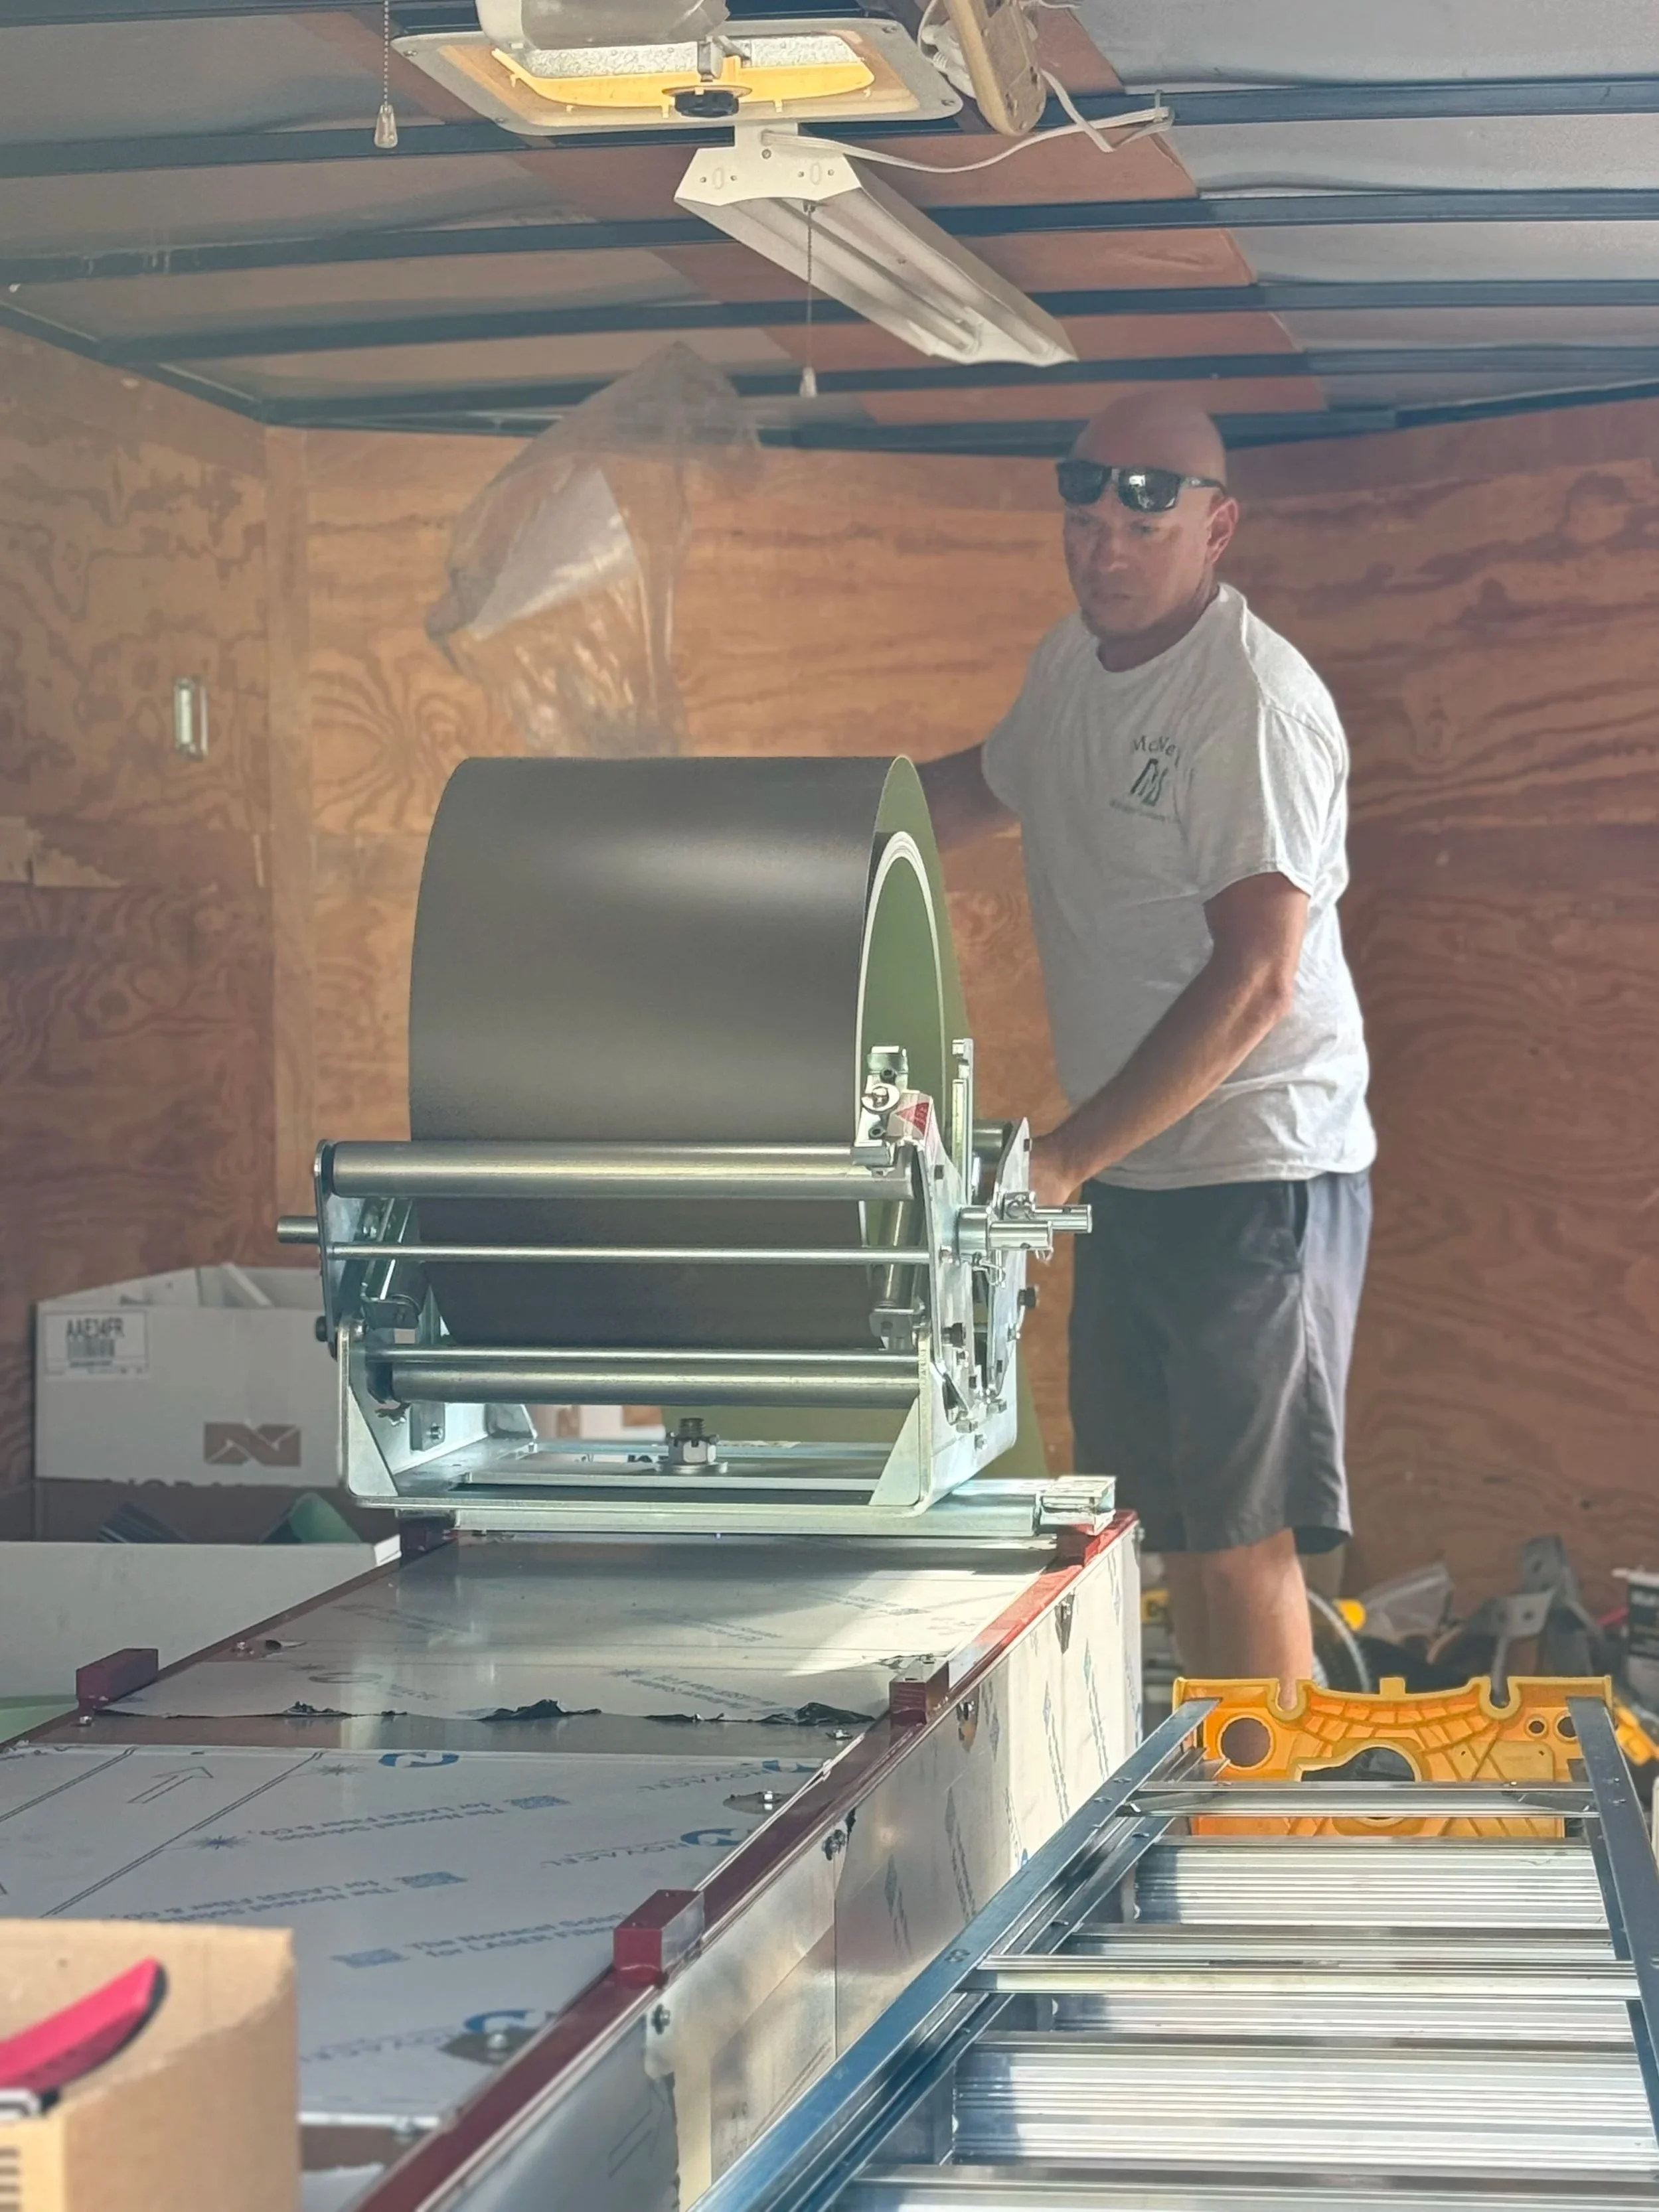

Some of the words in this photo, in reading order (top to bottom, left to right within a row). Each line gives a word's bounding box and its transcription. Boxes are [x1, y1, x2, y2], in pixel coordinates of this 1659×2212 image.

[378, 1807, 455, 1820] LASER
[321, 1817, 378, 1827] Fiber
[374, 1814, 463, 1829] Novacel
[273, 1826, 372, 1842] Solution
[256, 1886, 341, 1901] LASER
[190, 1899, 253, 1911] Fiber
[248, 1894, 349, 1912] Novacel
